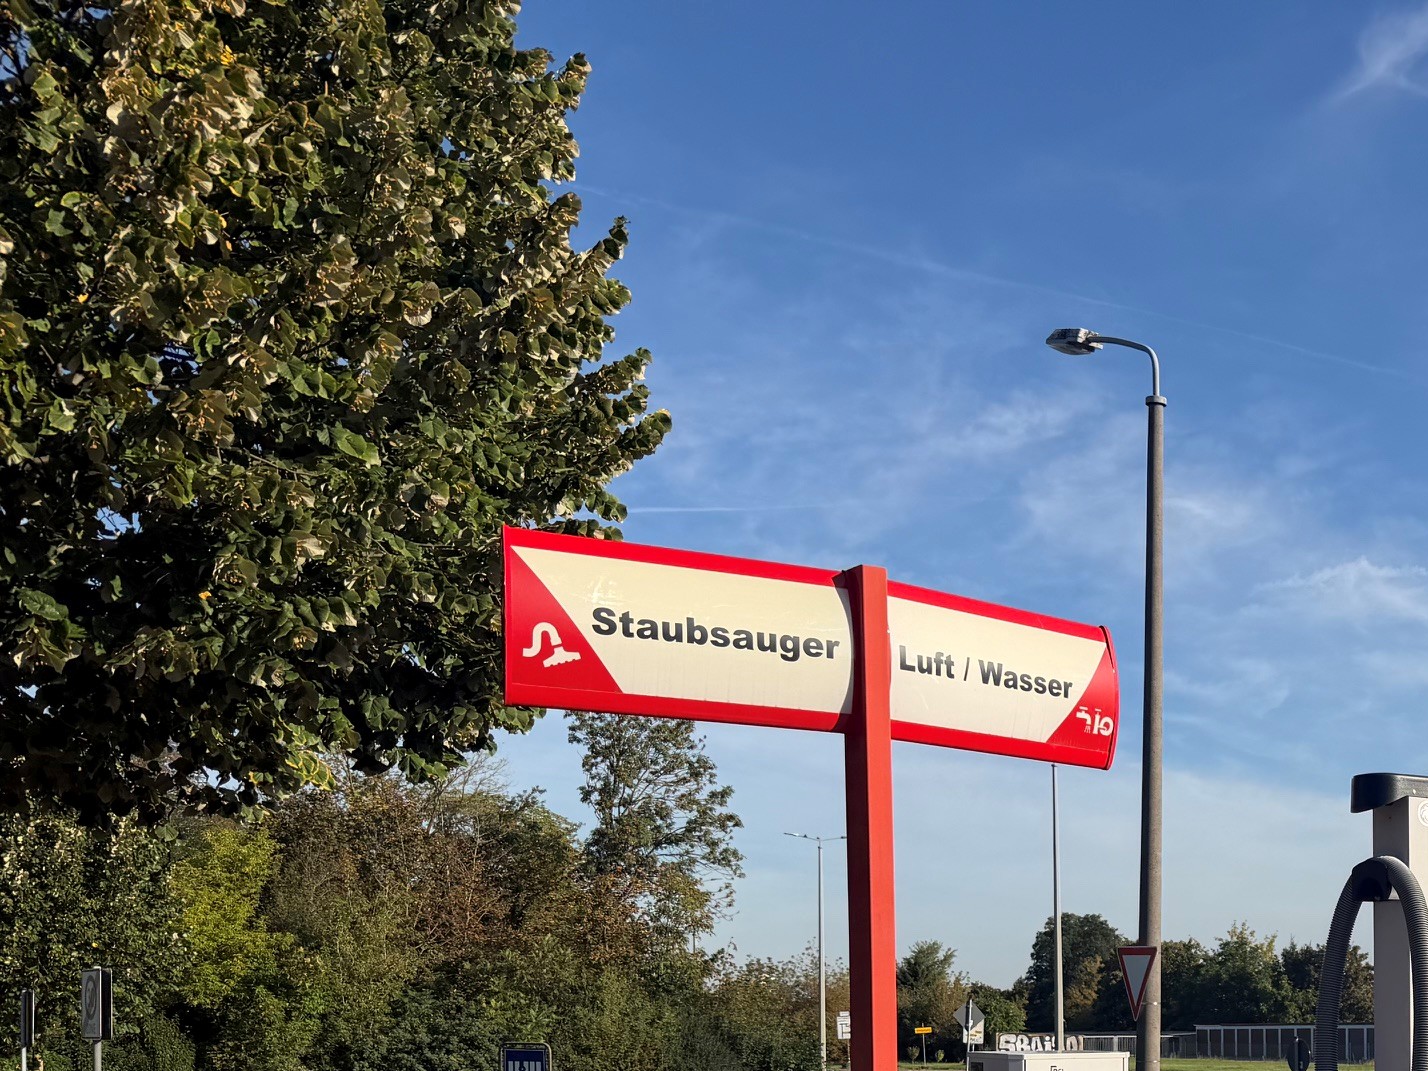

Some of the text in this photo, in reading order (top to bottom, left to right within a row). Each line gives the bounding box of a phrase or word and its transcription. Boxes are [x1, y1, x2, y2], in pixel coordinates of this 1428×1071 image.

[592, 607, 840, 663] Staubsauger
[899, 644, 1074, 699] Luft / Wasser
